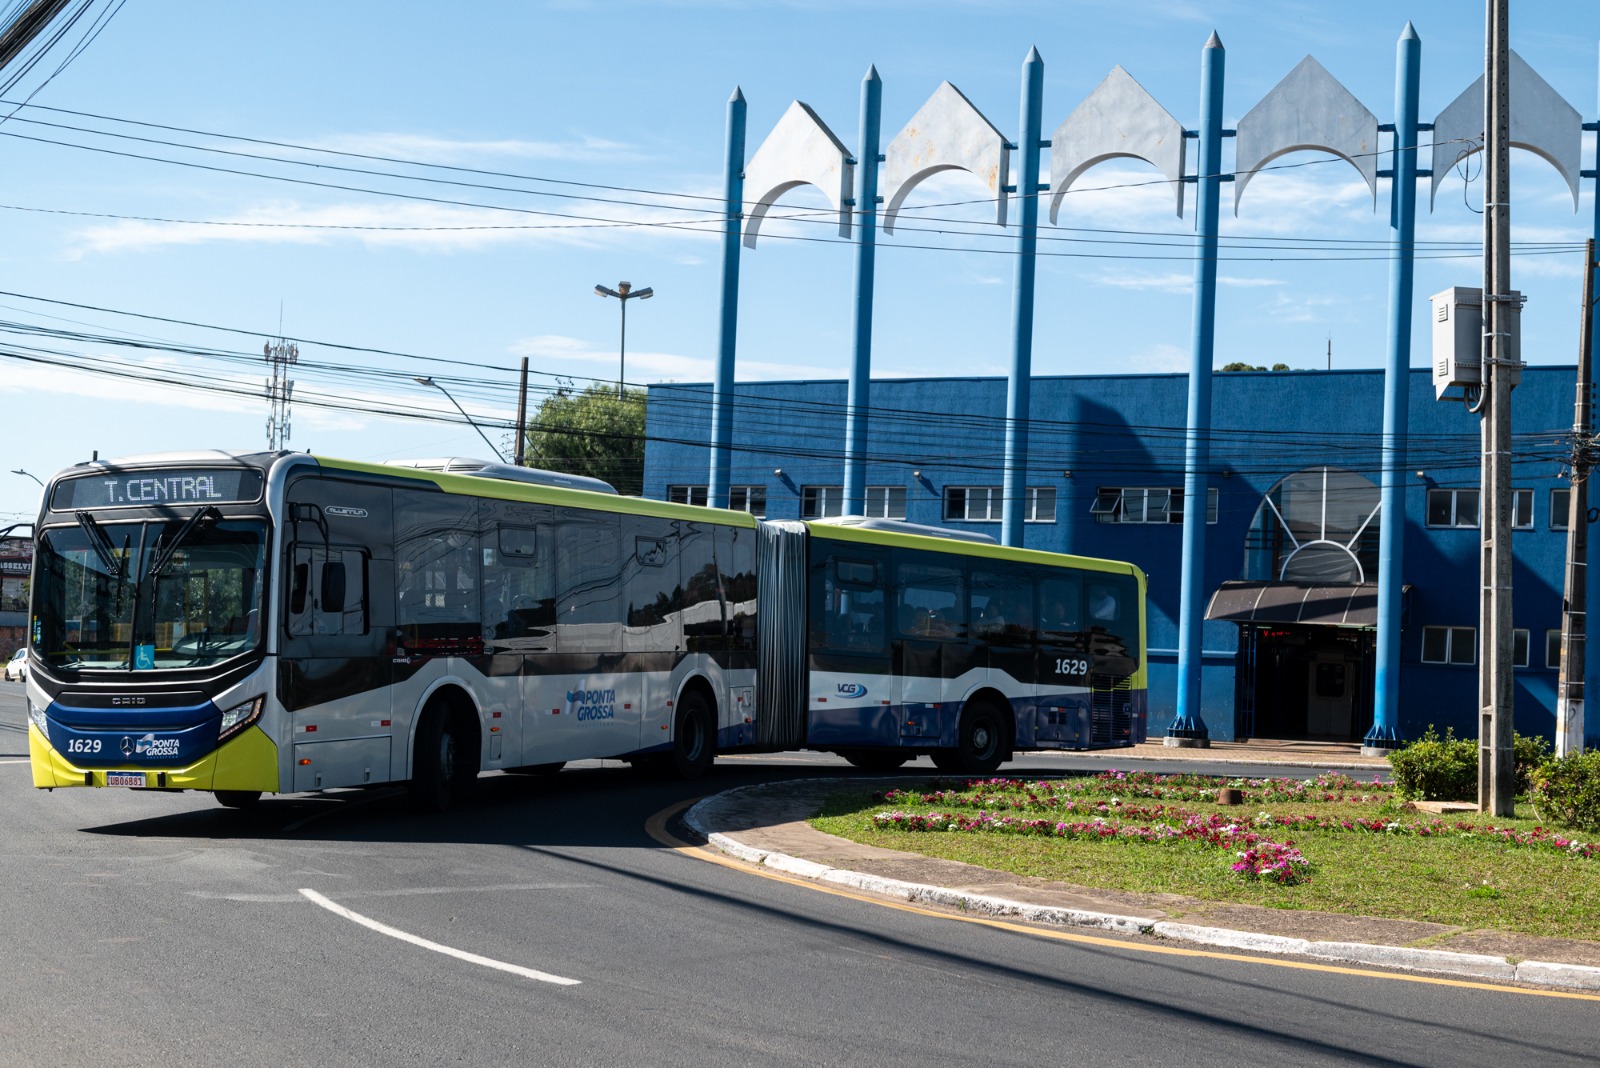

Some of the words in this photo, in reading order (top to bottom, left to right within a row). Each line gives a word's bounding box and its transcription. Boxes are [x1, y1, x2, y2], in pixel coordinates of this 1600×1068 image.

[104, 476, 222, 502] T.CENTRAL
[1055, 658, 1088, 675] 1629
[837, 683, 856, 694] VCG
[585, 689, 616, 705] PONTA
[577, 704, 614, 721] GROSSA
[67, 739, 102, 753] 1629
[146, 746, 179, 756] GROSSA
[152, 739, 180, 748] PONTA
